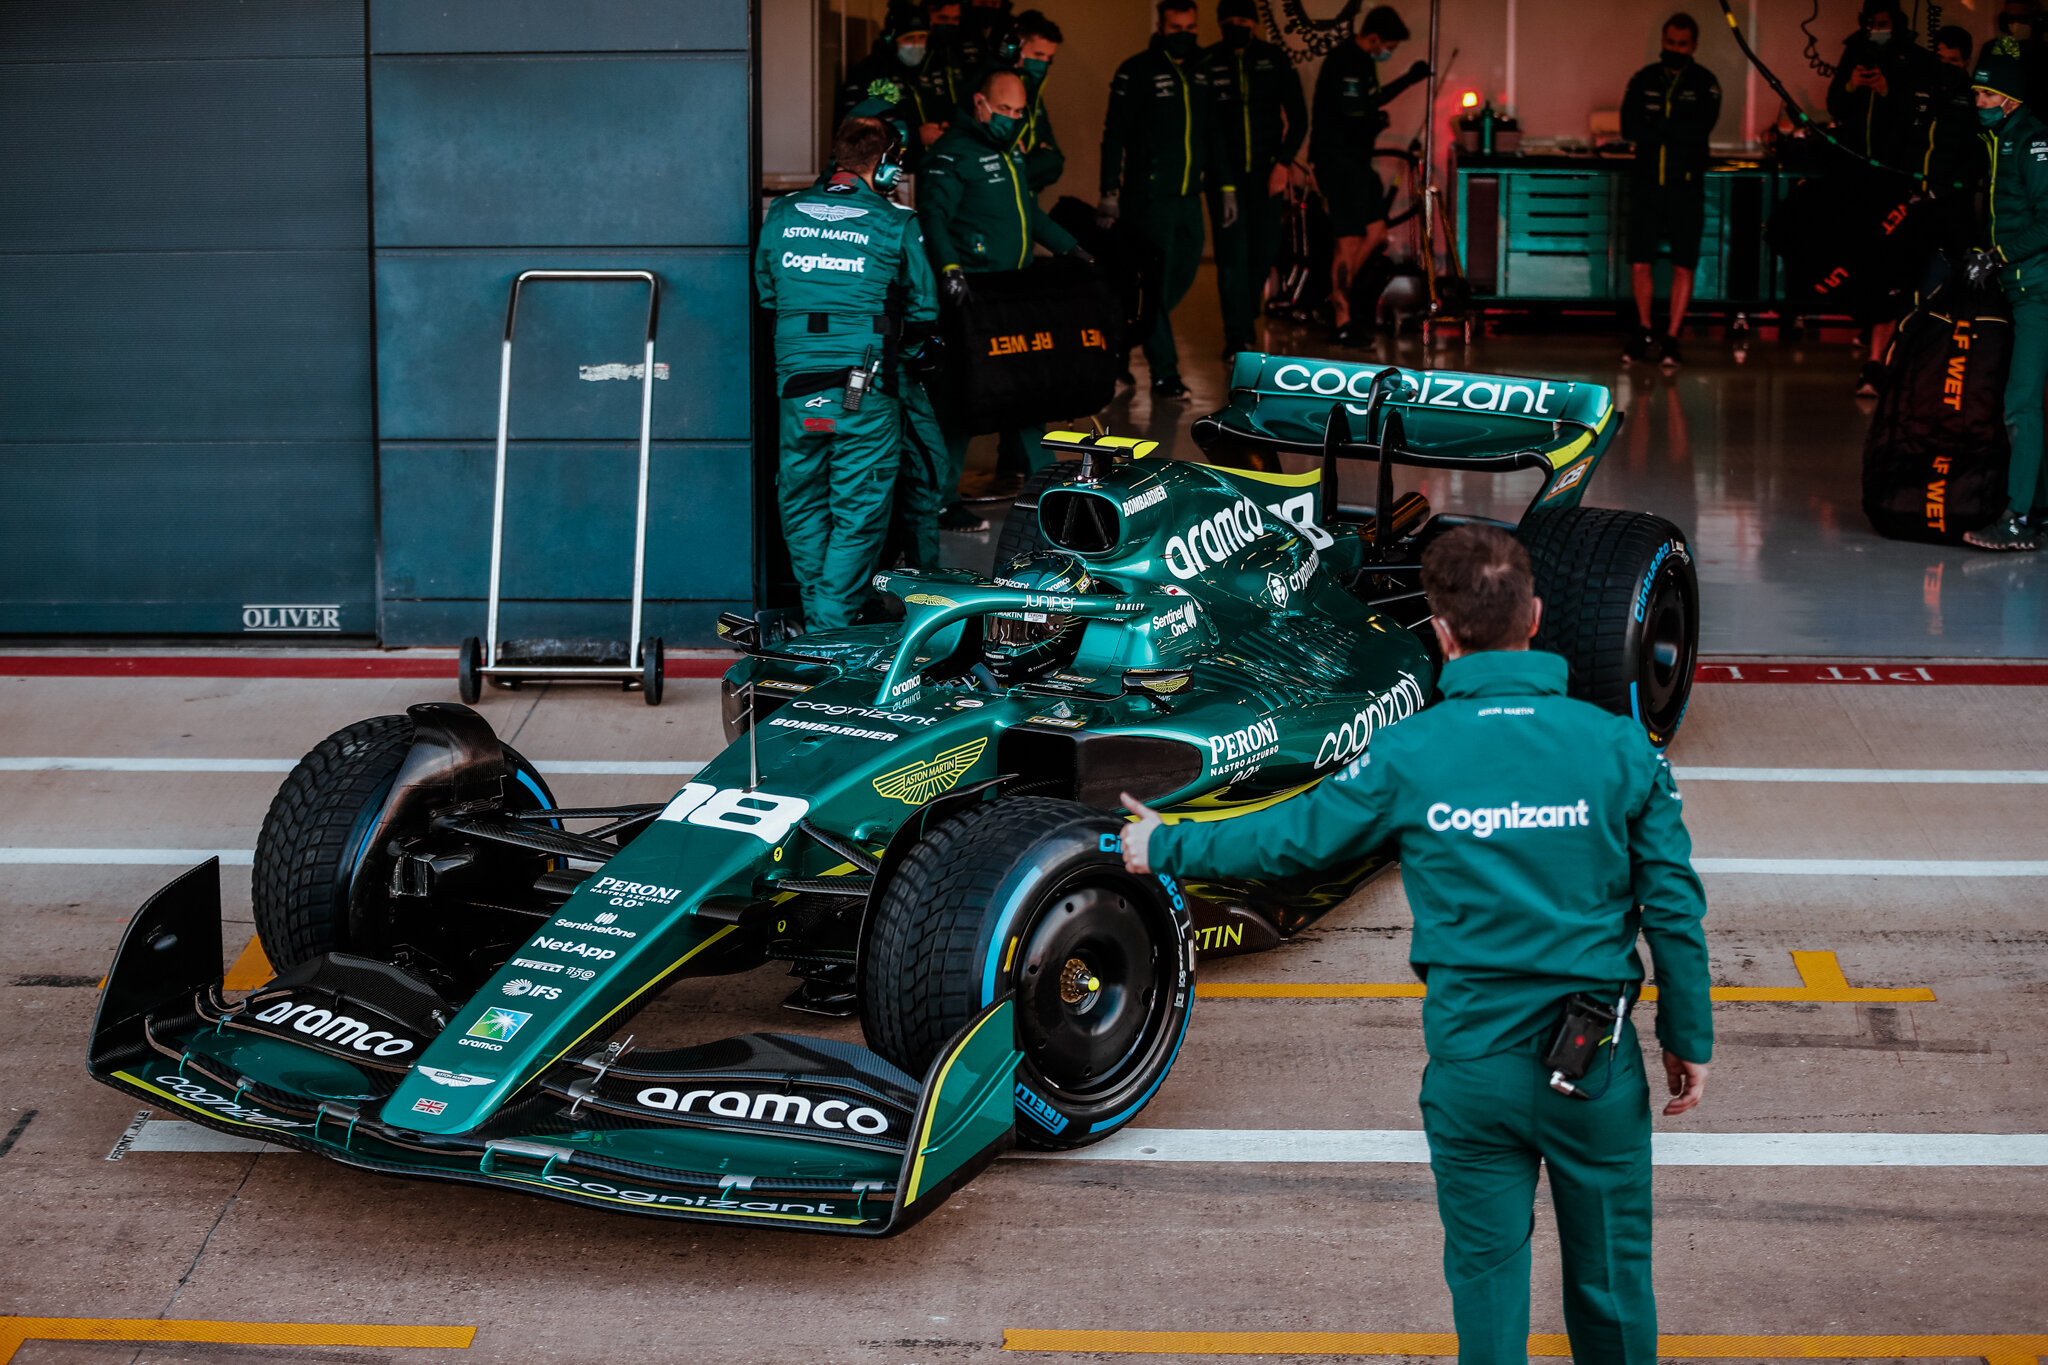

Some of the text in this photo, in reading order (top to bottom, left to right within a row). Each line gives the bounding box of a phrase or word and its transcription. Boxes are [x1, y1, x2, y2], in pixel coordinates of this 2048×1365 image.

[783, 227, 869, 245] ASTON MARTIN
[782, 251, 866, 273] Cognizant
[988, 331, 1053, 356] RF WET
[1943, 320, 1970, 411] LF WET
[1550, 463, 1586, 494] JCB
[1121, 485, 1168, 517] BOMBARDIER
[1926, 479, 1946, 533] WET
[1266, 492, 1335, 550] 18
[1165, 496, 1264, 580] aramco
[243, 606, 340, 629] OLIVER
[1115, 603, 1145, 611] OAKLEY
[1152, 604, 1184, 632] Sentinel
[1171, 620, 1188, 637] One
[763, 682, 809, 691] JCB
[892, 675, 920, 696] aramco
[792, 701, 938, 726] cognizant
[768, 718, 898, 742] BOMBARDIER
[1208, 717, 1279, 766] PERONI
[905, 757, 956, 787] ASTON MARTIN
[1210, 745, 1279, 777] NASTRO AZZURRO
[655, 782, 810, 844] 18
[1427, 800, 1589, 838] Cognizant
[1099, 833, 1185, 911] Ciato
[589, 888, 671, 905] NASTRO AZZURRO
[595, 877, 682, 900] PERONI
[555, 918, 637, 938] SentinelOne
[531, 936, 616, 960] NetApp
[511, 958, 565, 973] PIRELLI
[528, 985, 562, 1000] IFS
[255, 1001, 414, 1056] aramco
[458, 1038, 503, 1052] aramco
[636, 1087, 889, 1135] aramco
[1014, 1081, 1070, 1136] PIRELLI
[110, 1134, 135, 1160] FRONT
[546, 1175, 835, 1215] cognizant
